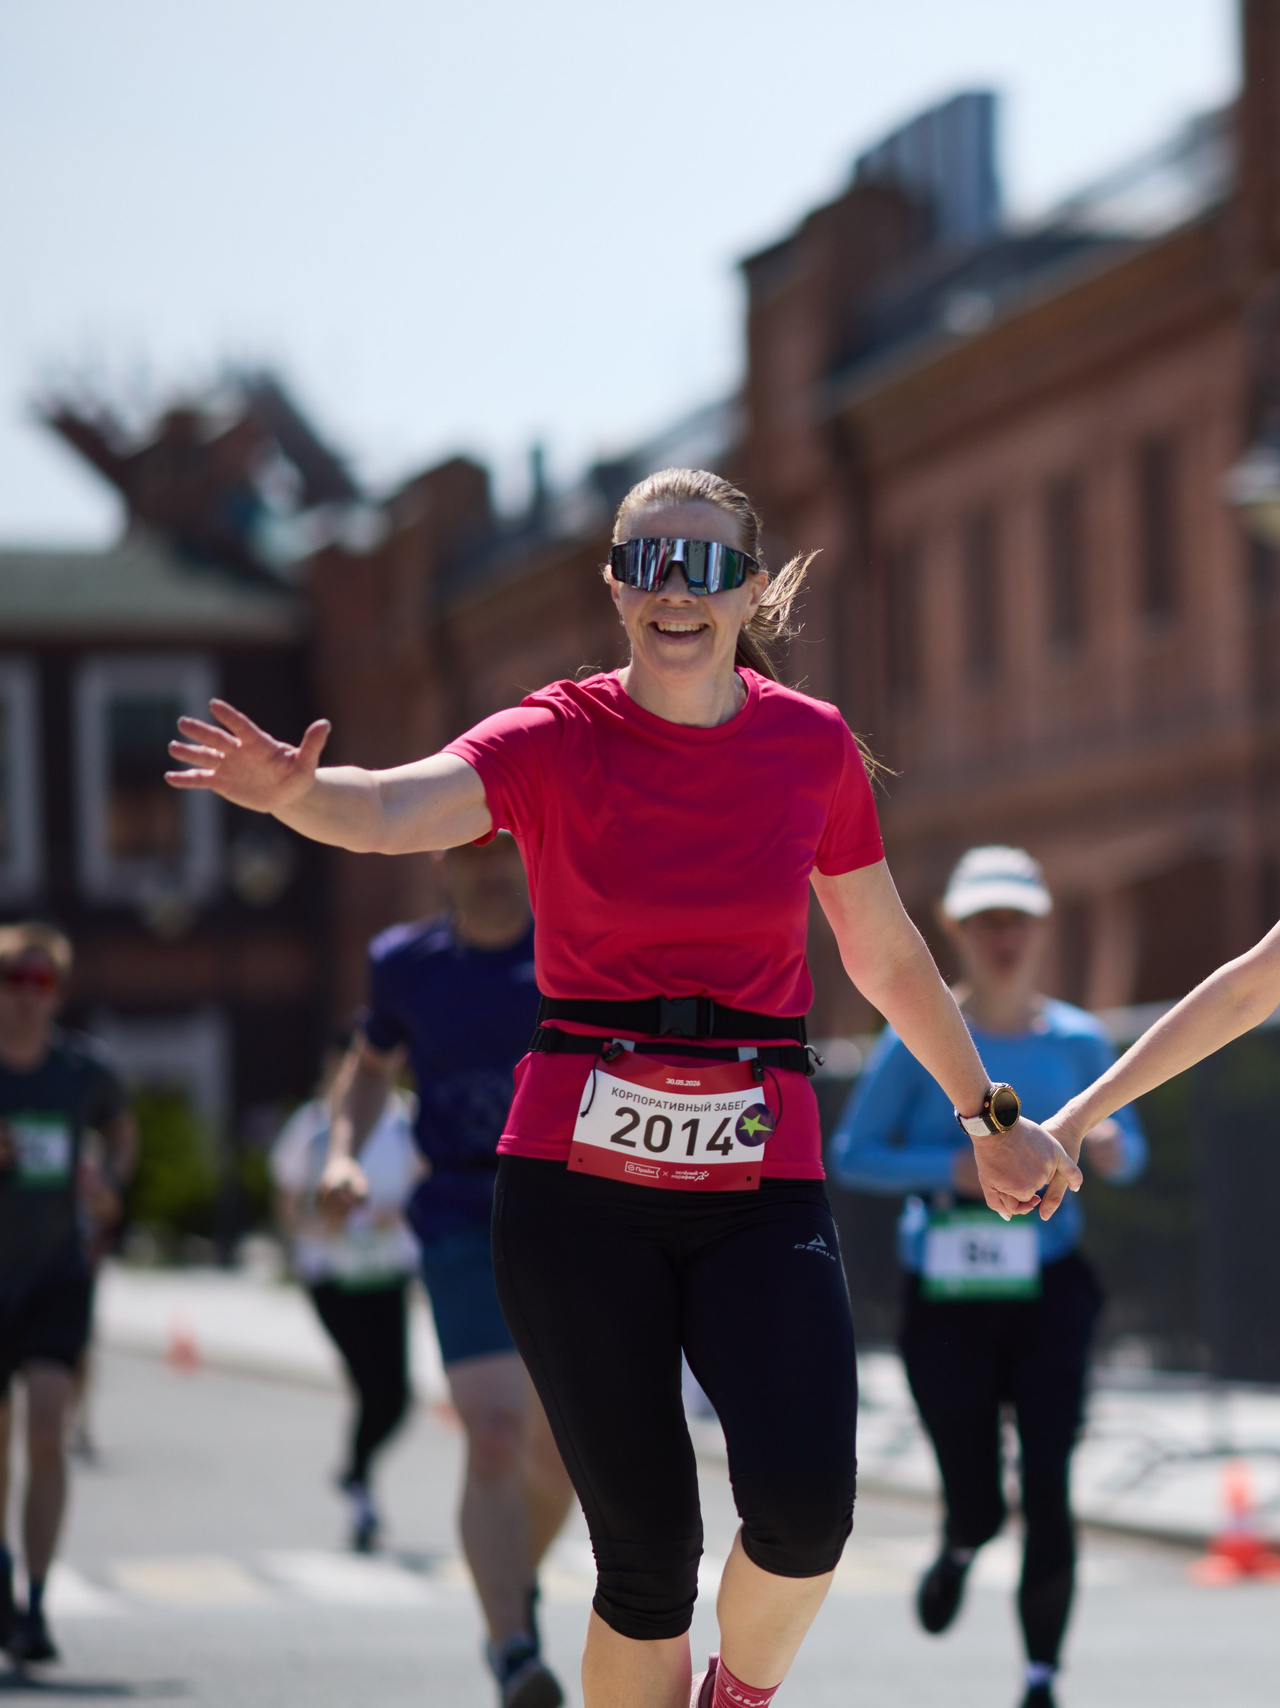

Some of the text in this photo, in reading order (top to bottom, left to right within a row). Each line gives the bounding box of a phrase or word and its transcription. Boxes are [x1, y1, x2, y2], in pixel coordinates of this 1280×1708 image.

[666, 1078, 701, 1087] 30.05.2026
[611, 1086, 747, 1112] КОРПОРАТИВНЫЙ ЗАБЕГ
[610, 1106, 734, 1157] 2014
[635, 1166, 655, 1175] Прайм
[793, 1243, 837, 1262] DEMIX
